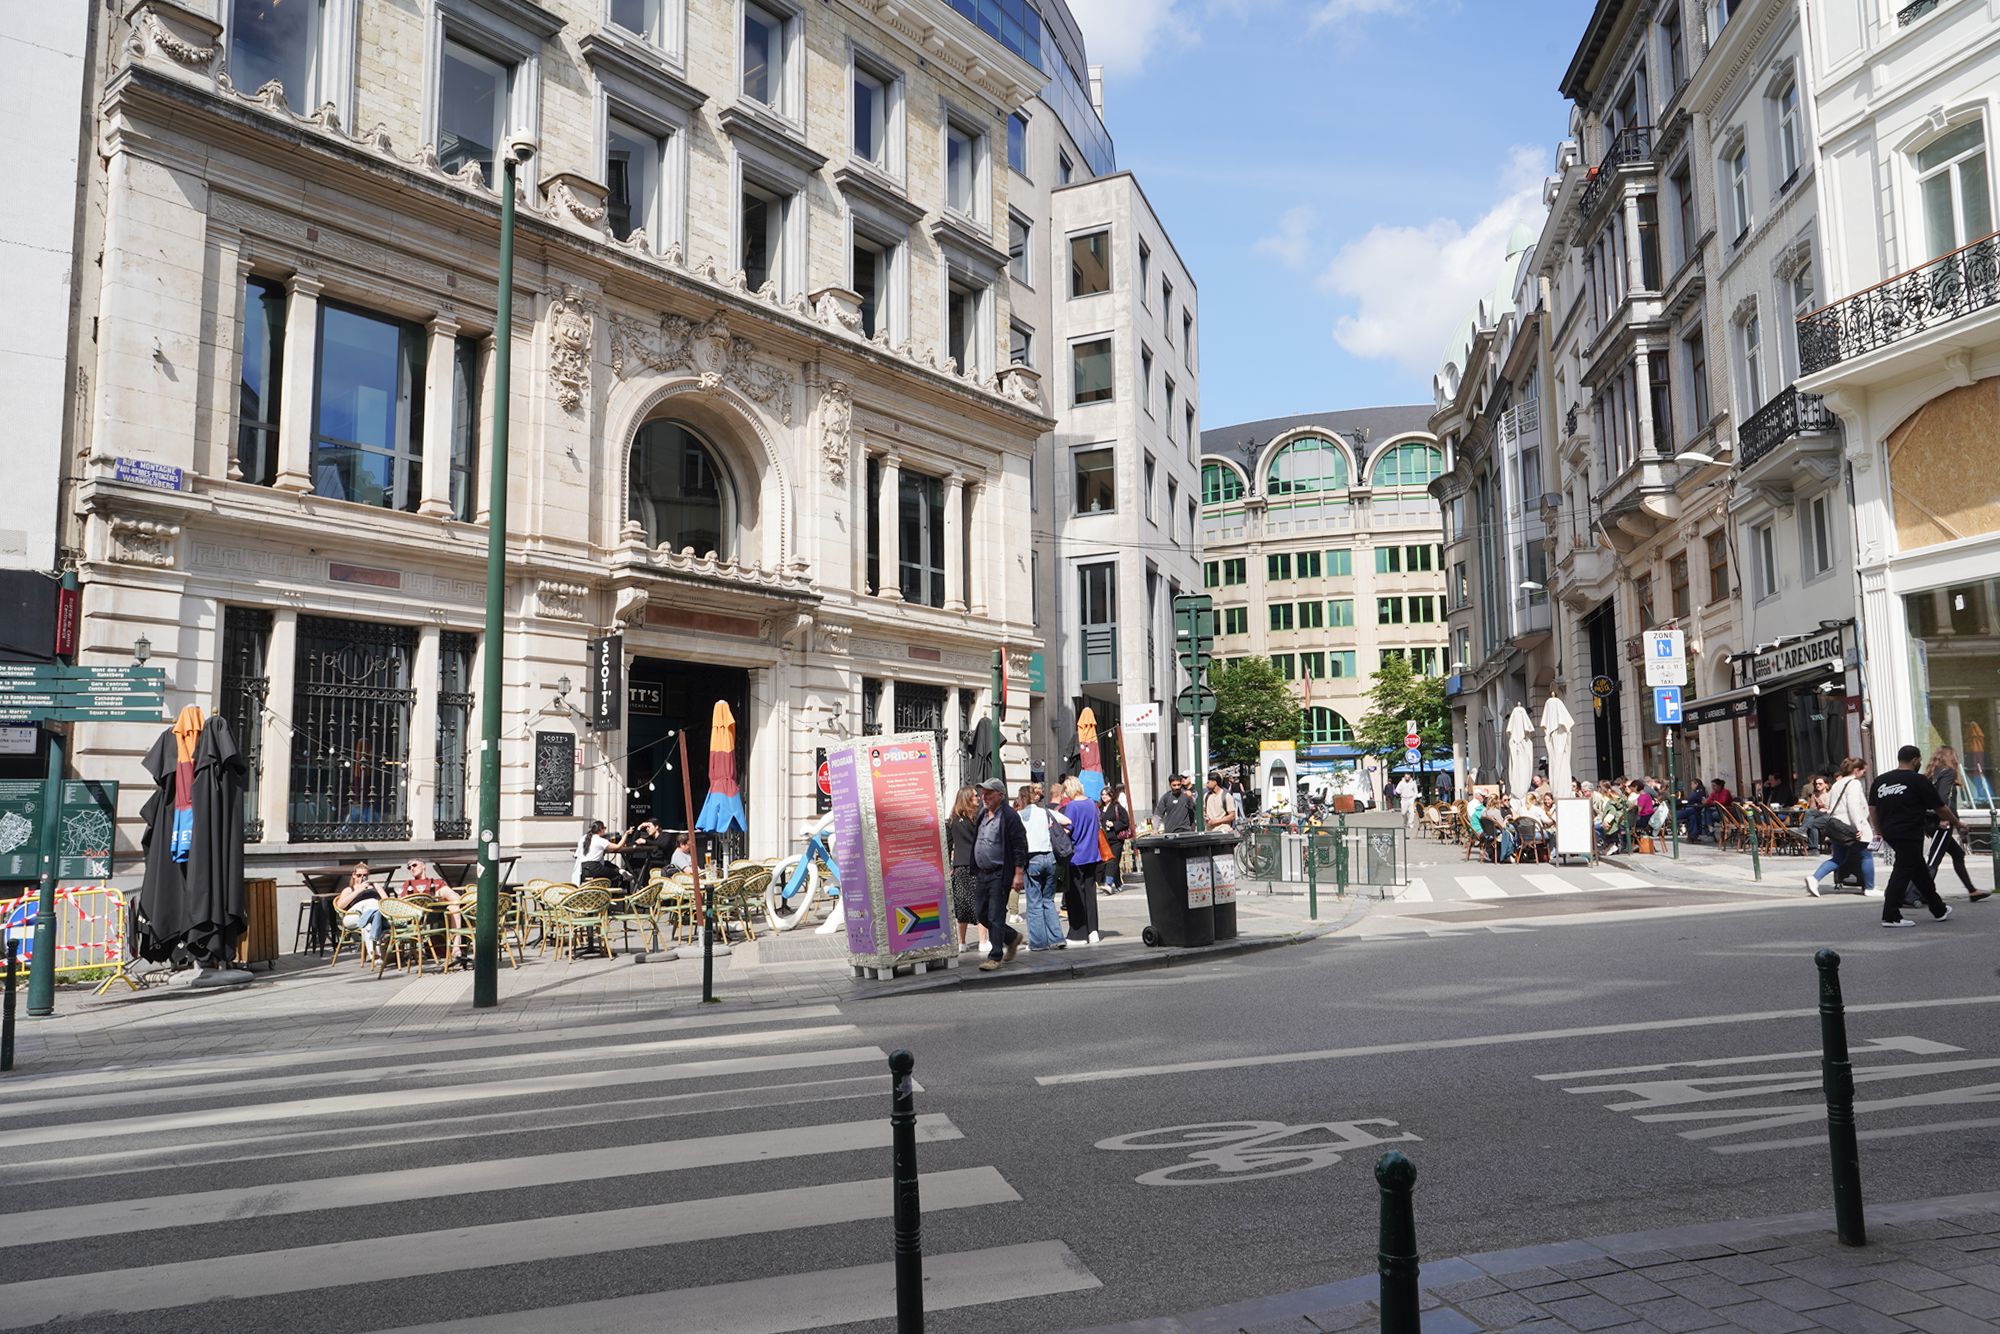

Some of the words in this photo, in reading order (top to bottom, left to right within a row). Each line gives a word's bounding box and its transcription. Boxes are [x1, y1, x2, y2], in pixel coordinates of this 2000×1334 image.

[122, 458, 137, 467] RUE
[140, 461, 176, 475] MONTAGNE
[122, 473, 175, 490] WARMOESBERG
[1653, 631, 1674, 639] ZONE
[1775, 636, 1840, 673] L'ARENBERG
[601, 640, 612, 716] SCOTT'S
[1406, 737, 1420, 745] STOP
[883, 750, 916, 762] PRIDE
